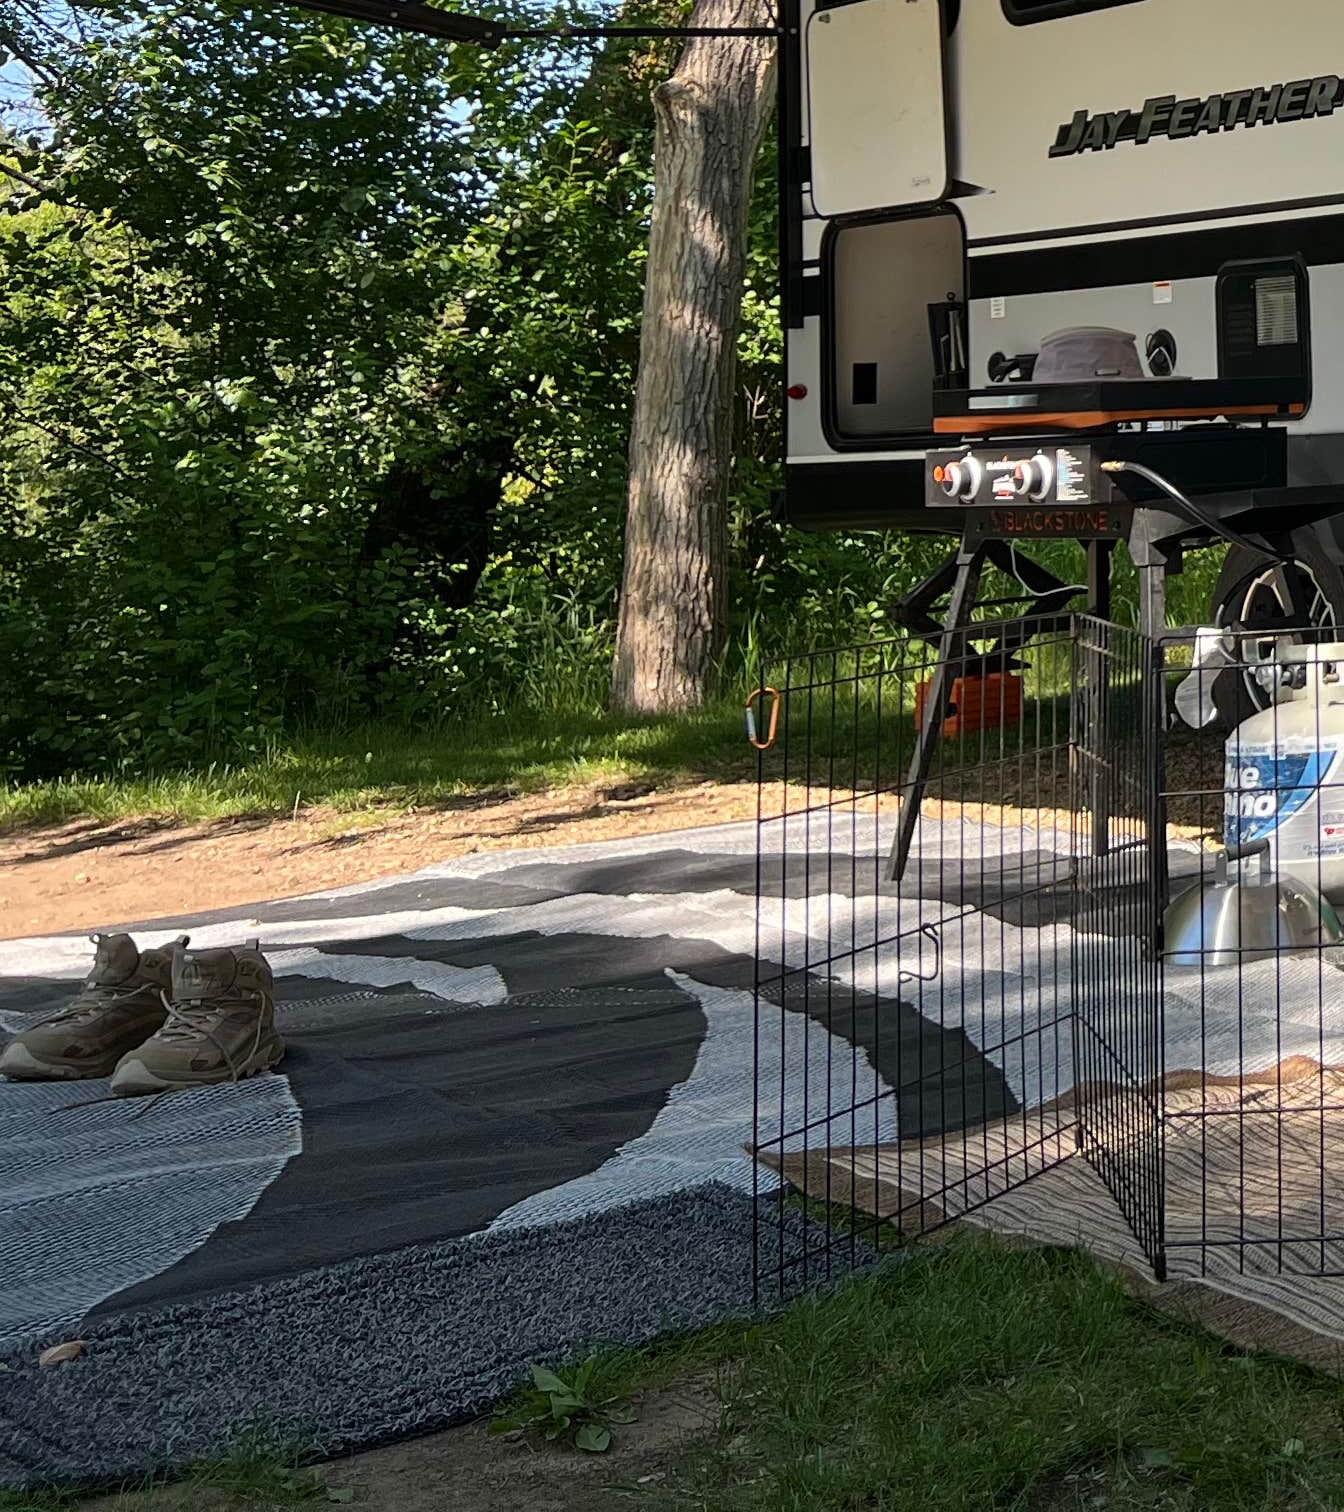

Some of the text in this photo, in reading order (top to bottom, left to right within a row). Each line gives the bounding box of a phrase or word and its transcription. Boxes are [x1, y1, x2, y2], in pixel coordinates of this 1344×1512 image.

[1049, 74, 1344, 158] JAY FEATHER
[1007, 511, 1107, 532] BLACKSTONE
[1224, 762, 1259, 788] lue
